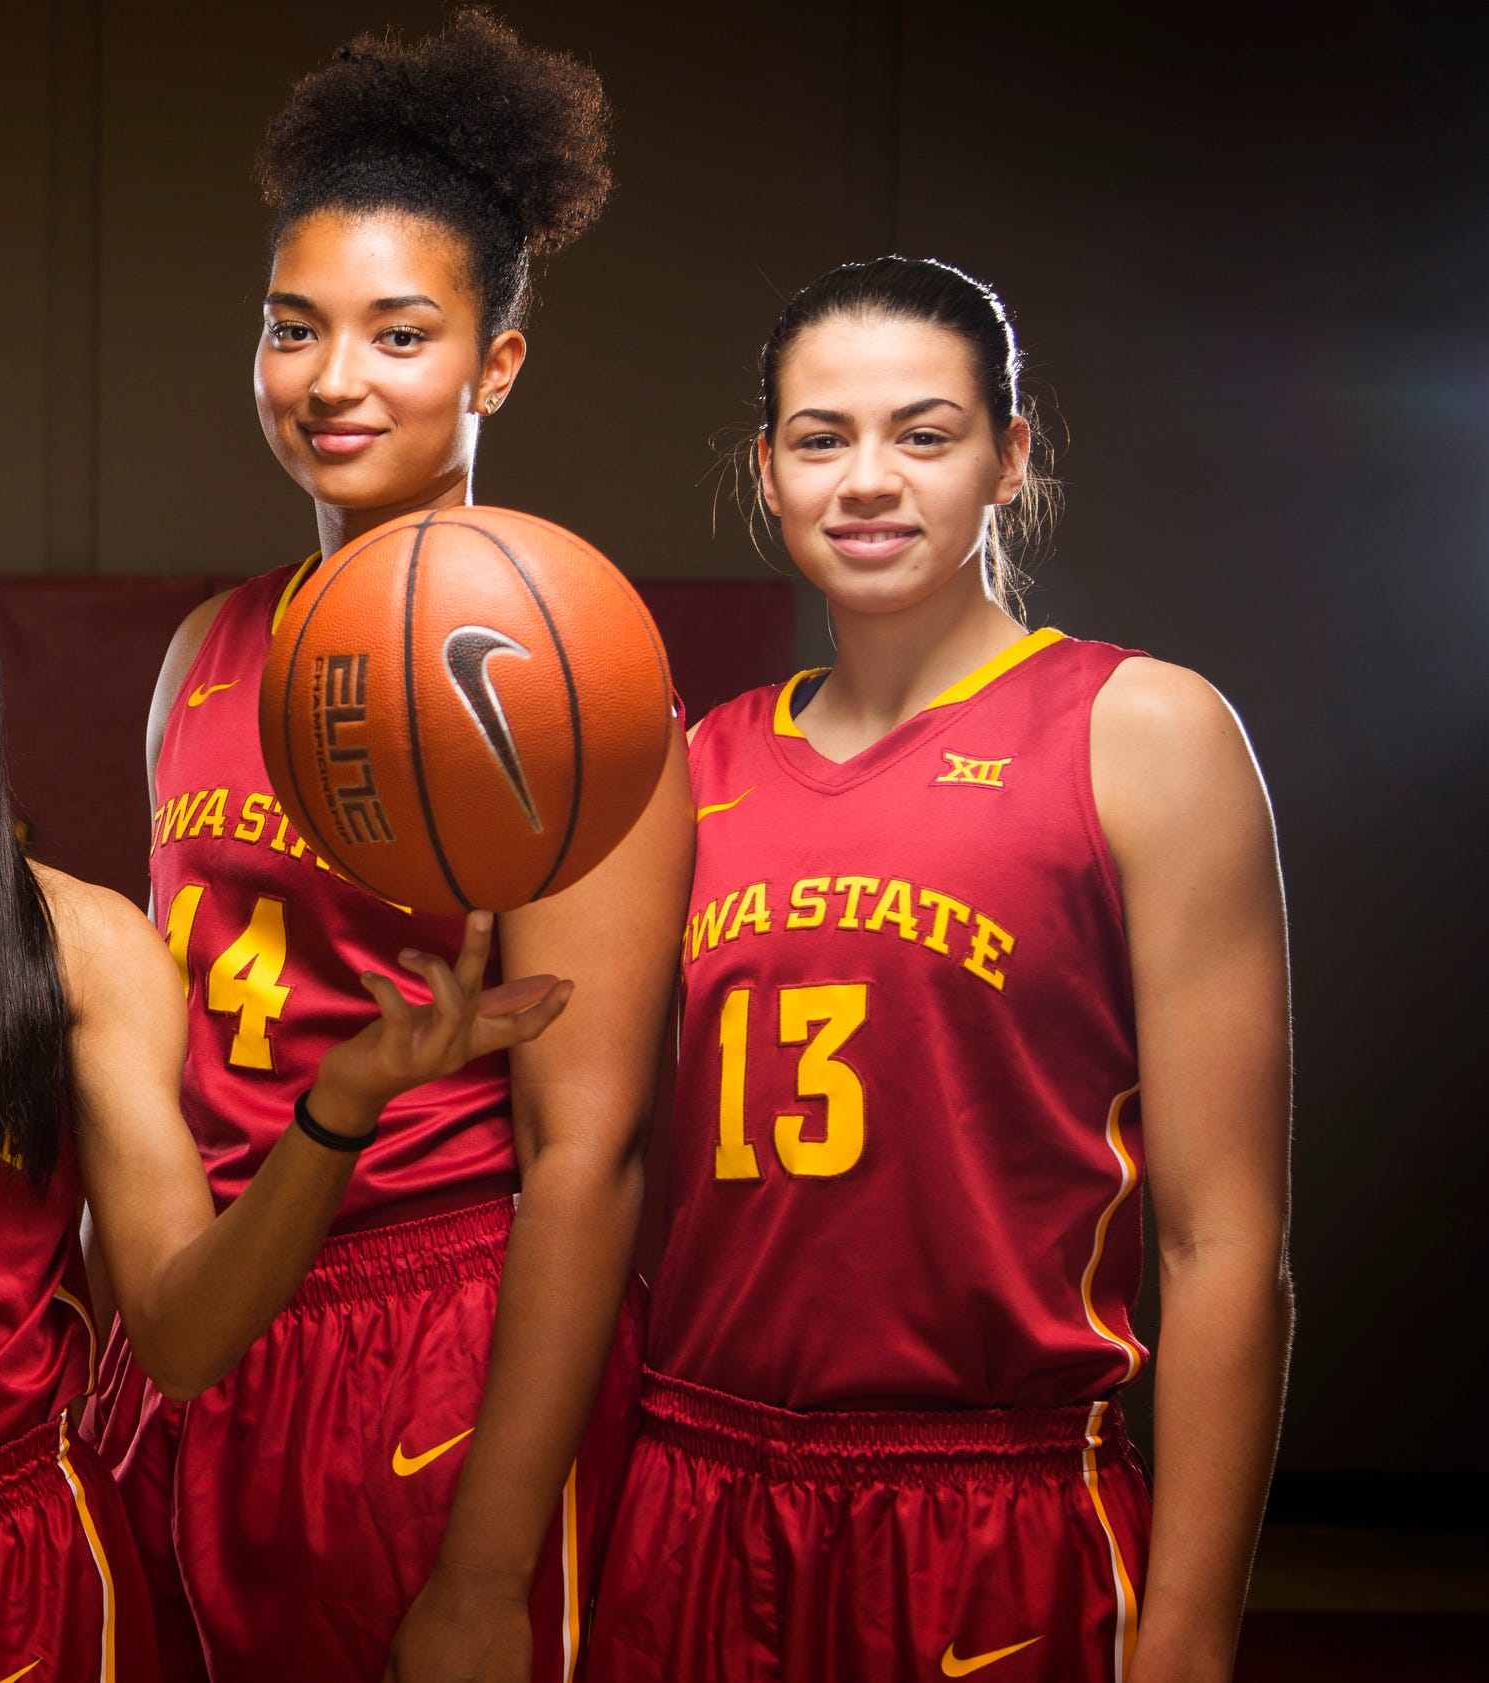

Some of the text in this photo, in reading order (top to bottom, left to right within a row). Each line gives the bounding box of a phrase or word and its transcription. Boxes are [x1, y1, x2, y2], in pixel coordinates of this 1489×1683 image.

[312, 656, 352, 845] CHAMPIONSHIP
[324, 653, 398, 845] ELITE
[935, 752, 1015, 787] XII
[166, 884, 291, 1070] 14
[785, 875, 1015, 991] STATE
[715, 983, 868, 1180] 13
